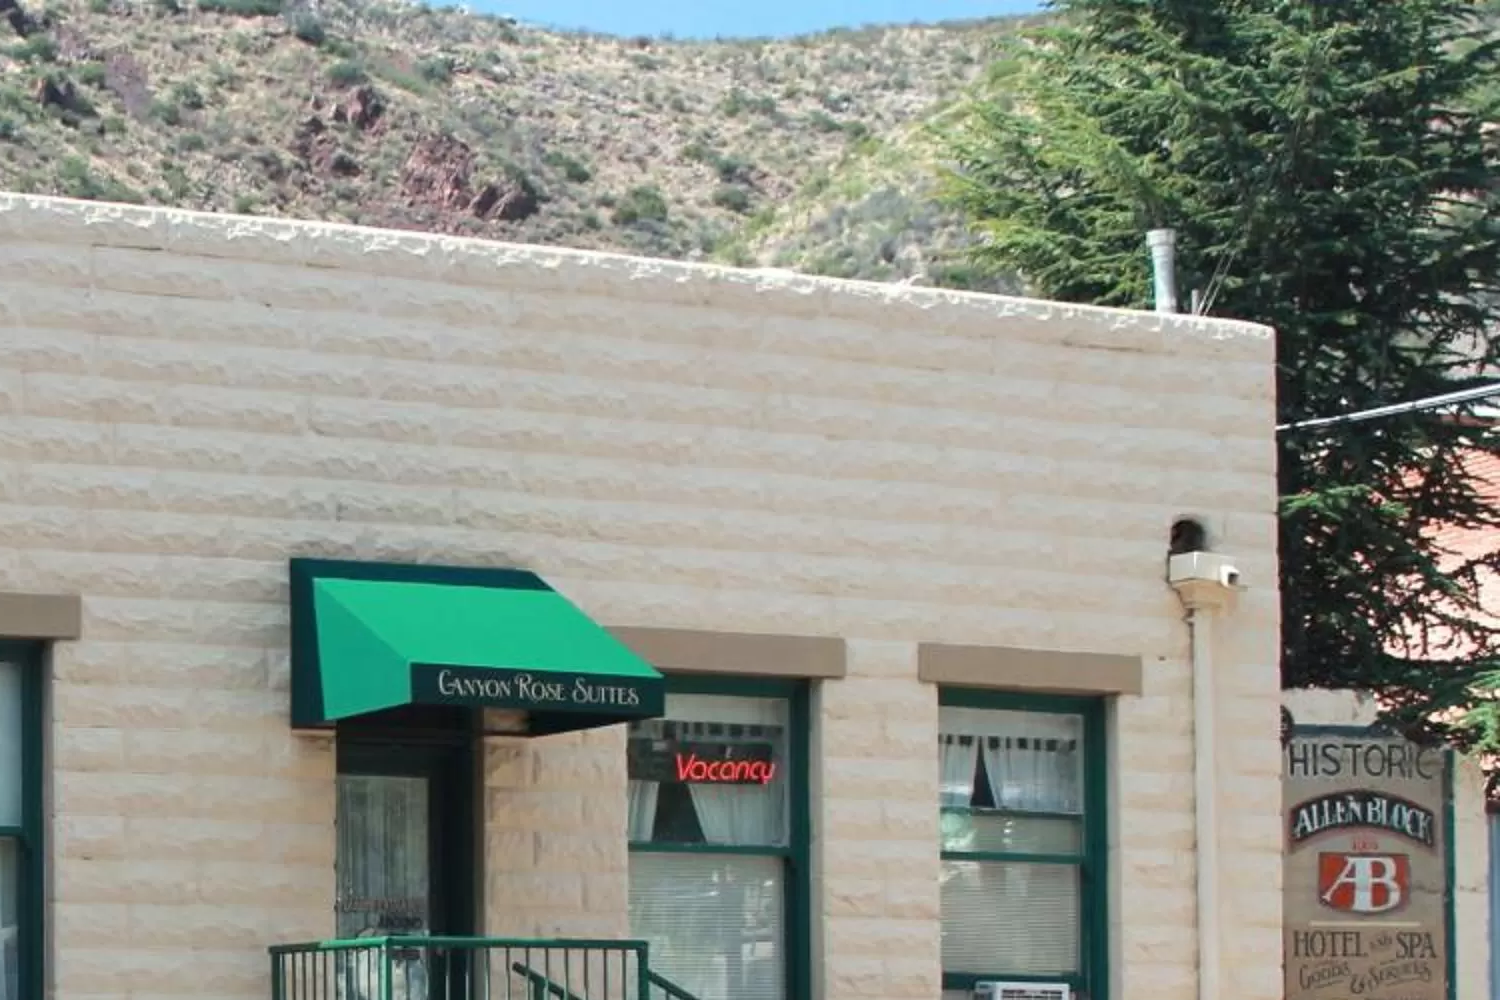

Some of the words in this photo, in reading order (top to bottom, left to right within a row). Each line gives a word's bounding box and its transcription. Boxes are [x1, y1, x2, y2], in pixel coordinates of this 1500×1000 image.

[438, 670, 511, 697] CANYON
[514, 673, 565, 700] ROSE
[572, 677, 639, 705] SUITES
[676, 754, 775, 784] Vacancy
[1290, 743, 1432, 780] HISTORIC
[1293, 795, 1363, 837] ALLEN
[1366, 797, 1432, 844] BLOCK
[1320, 856, 1401, 911] AB
[1293, 930, 1368, 957] HOTEL
[1396, 931, 1437, 959] SPA
